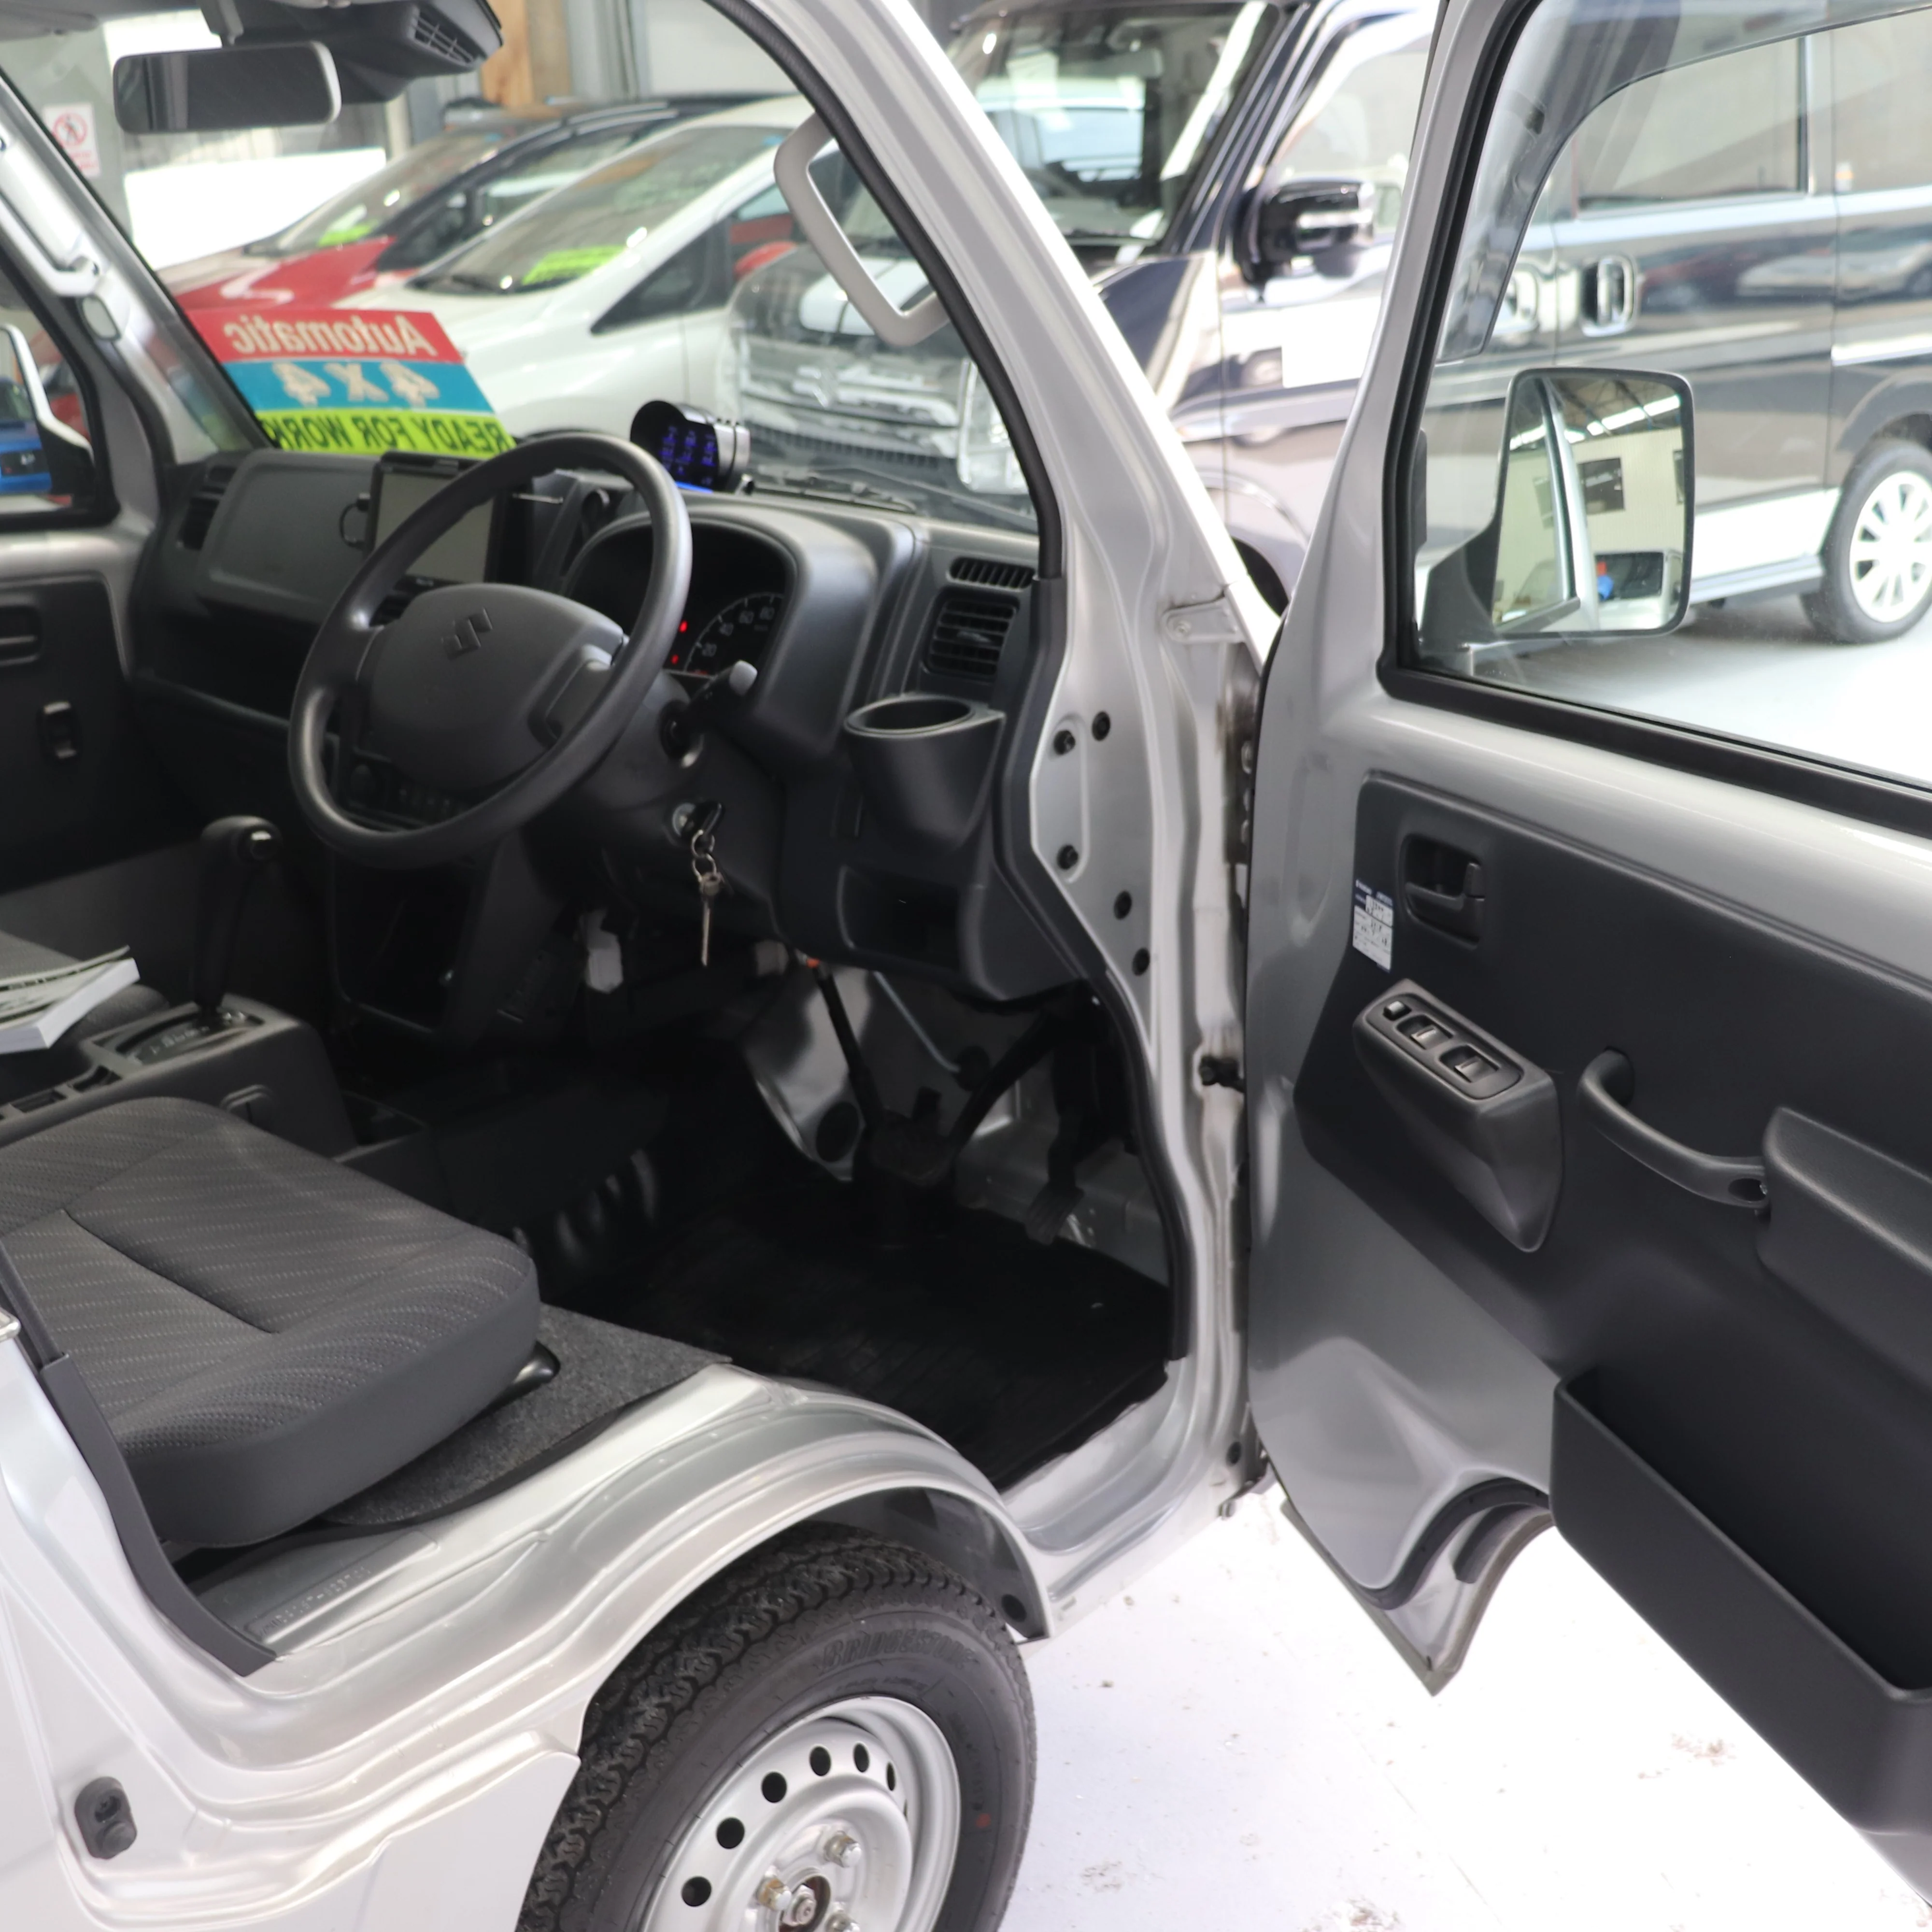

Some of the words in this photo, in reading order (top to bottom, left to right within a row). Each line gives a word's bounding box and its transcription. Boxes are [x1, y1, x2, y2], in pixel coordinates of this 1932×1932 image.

[739, 610, 754, 625] 60
[701, 642, 717, 657] 20
[819, 1628, 980, 1673] BRIDGESTONE
